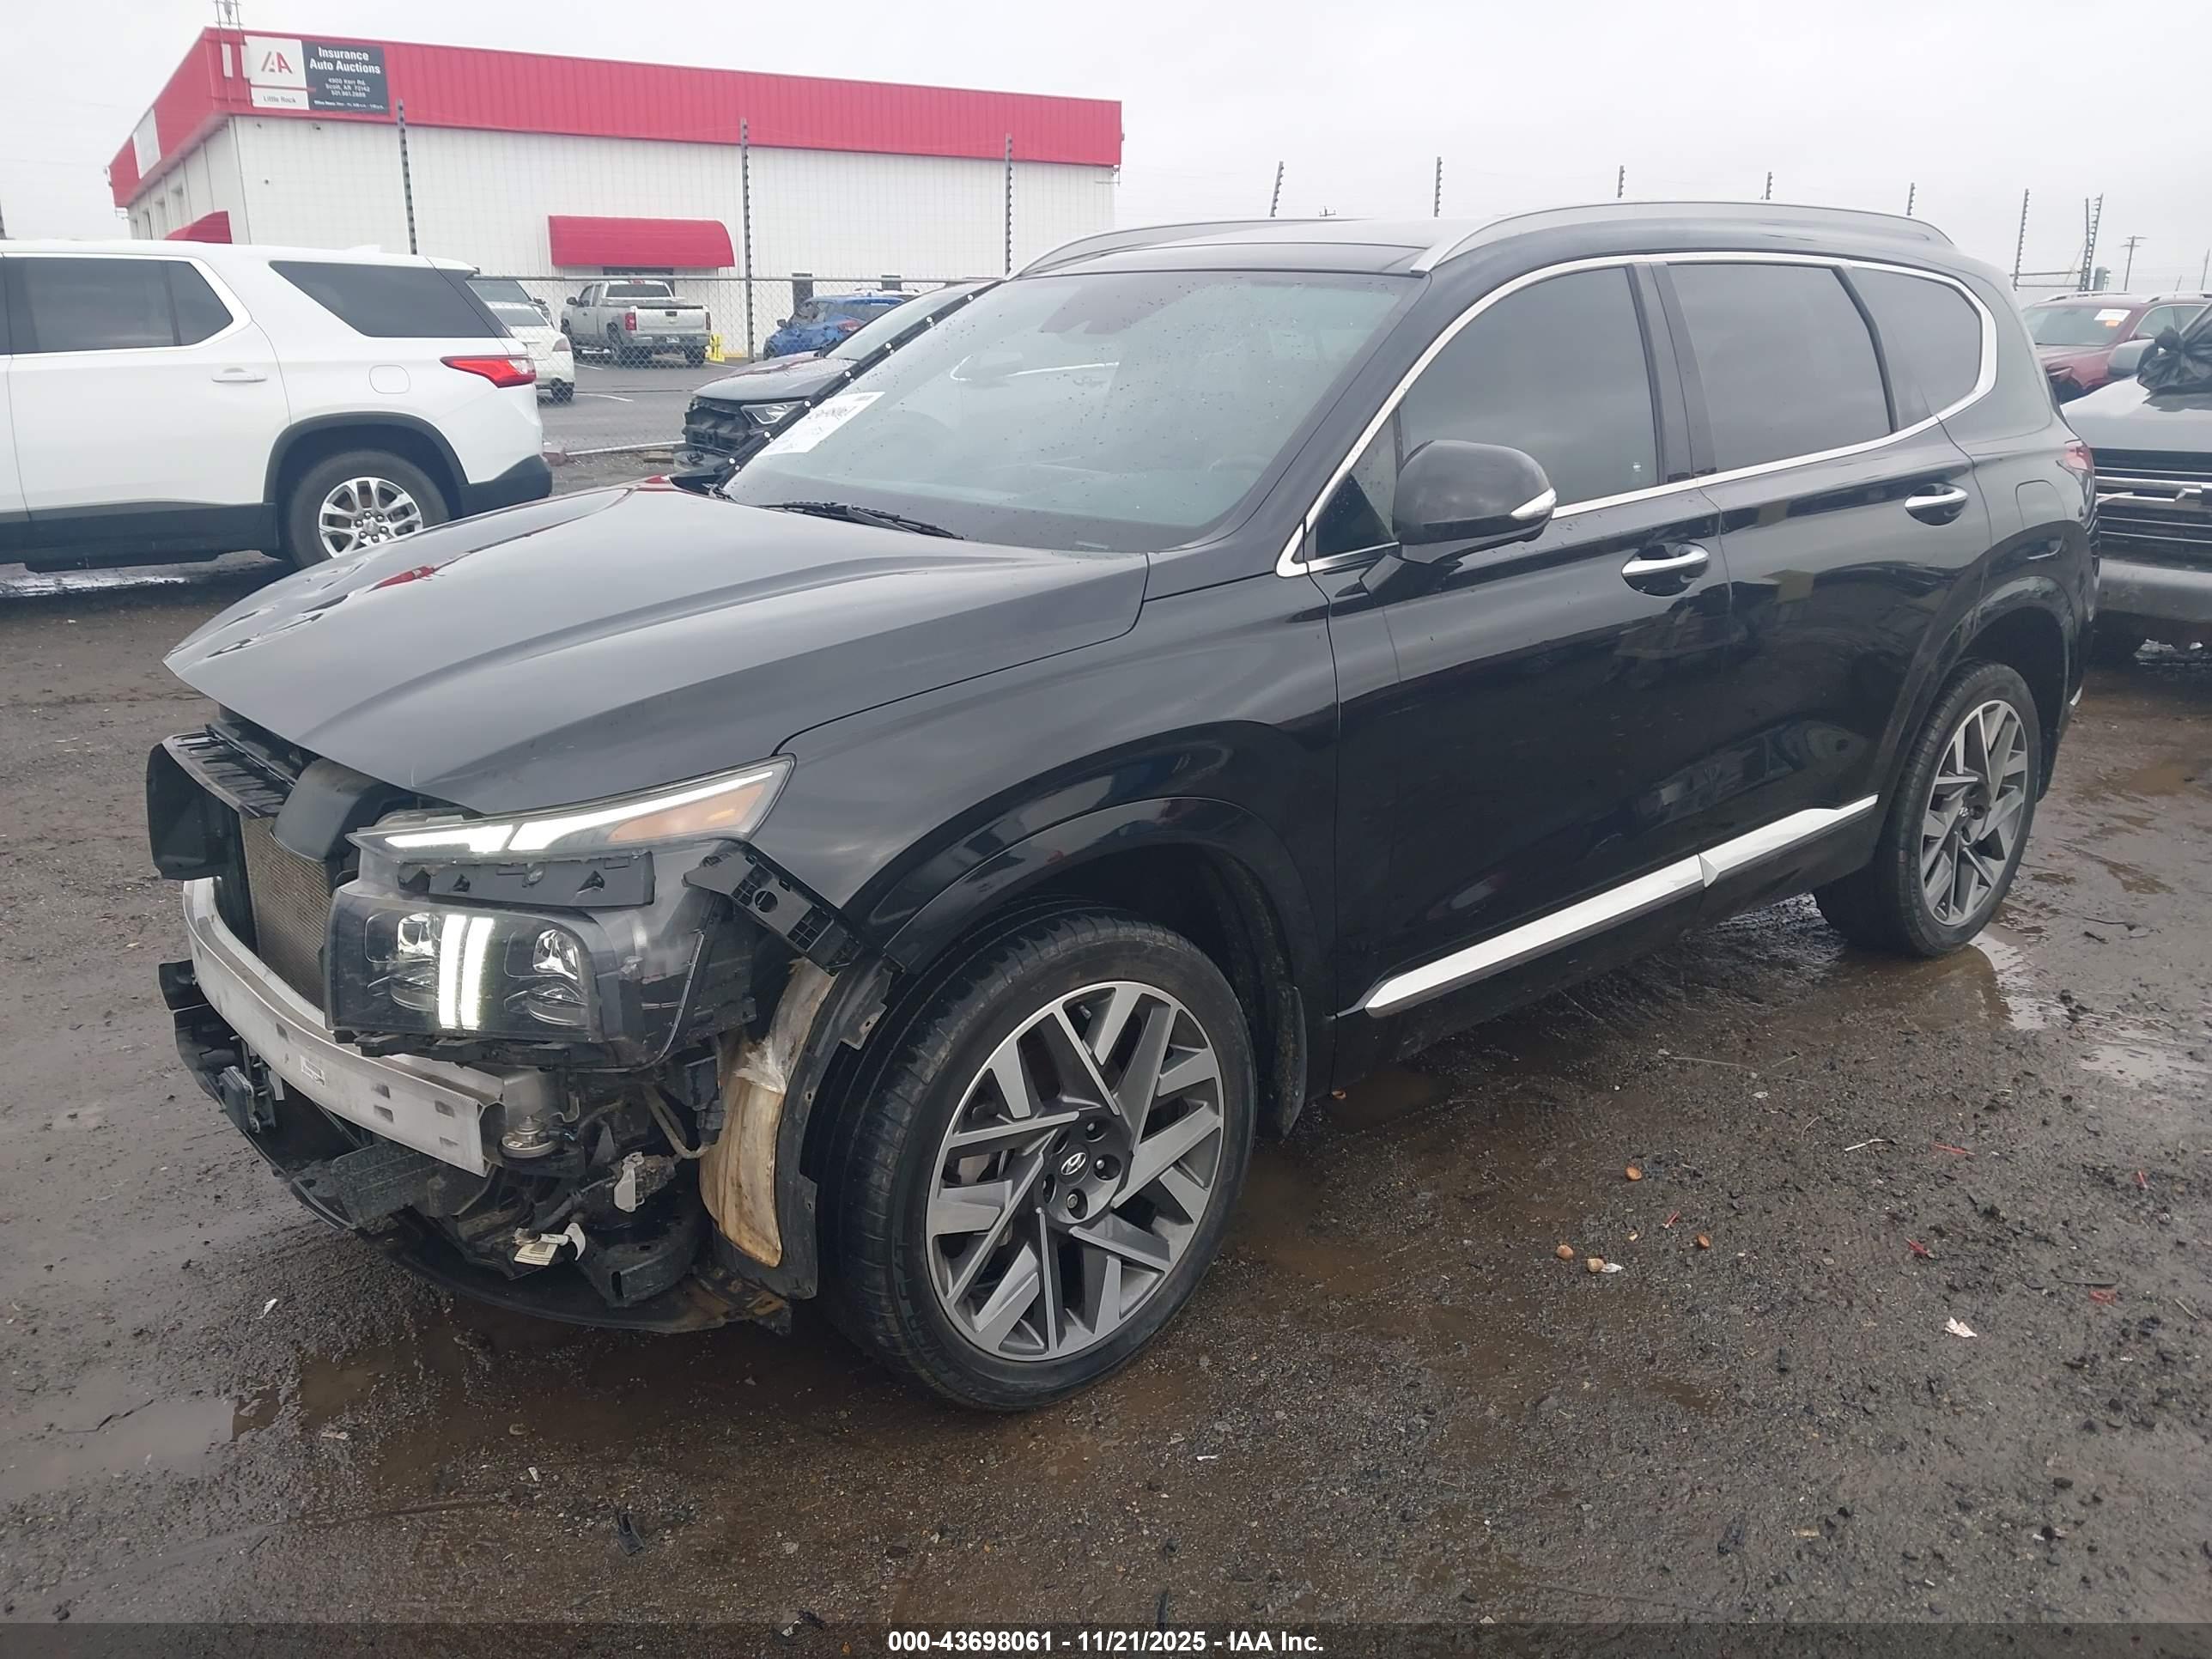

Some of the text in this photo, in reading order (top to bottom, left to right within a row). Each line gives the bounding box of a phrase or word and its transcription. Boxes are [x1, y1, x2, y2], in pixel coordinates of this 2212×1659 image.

[318, 46, 369, 60] Insurance
[309, 58, 381, 75] Auto Auctions
